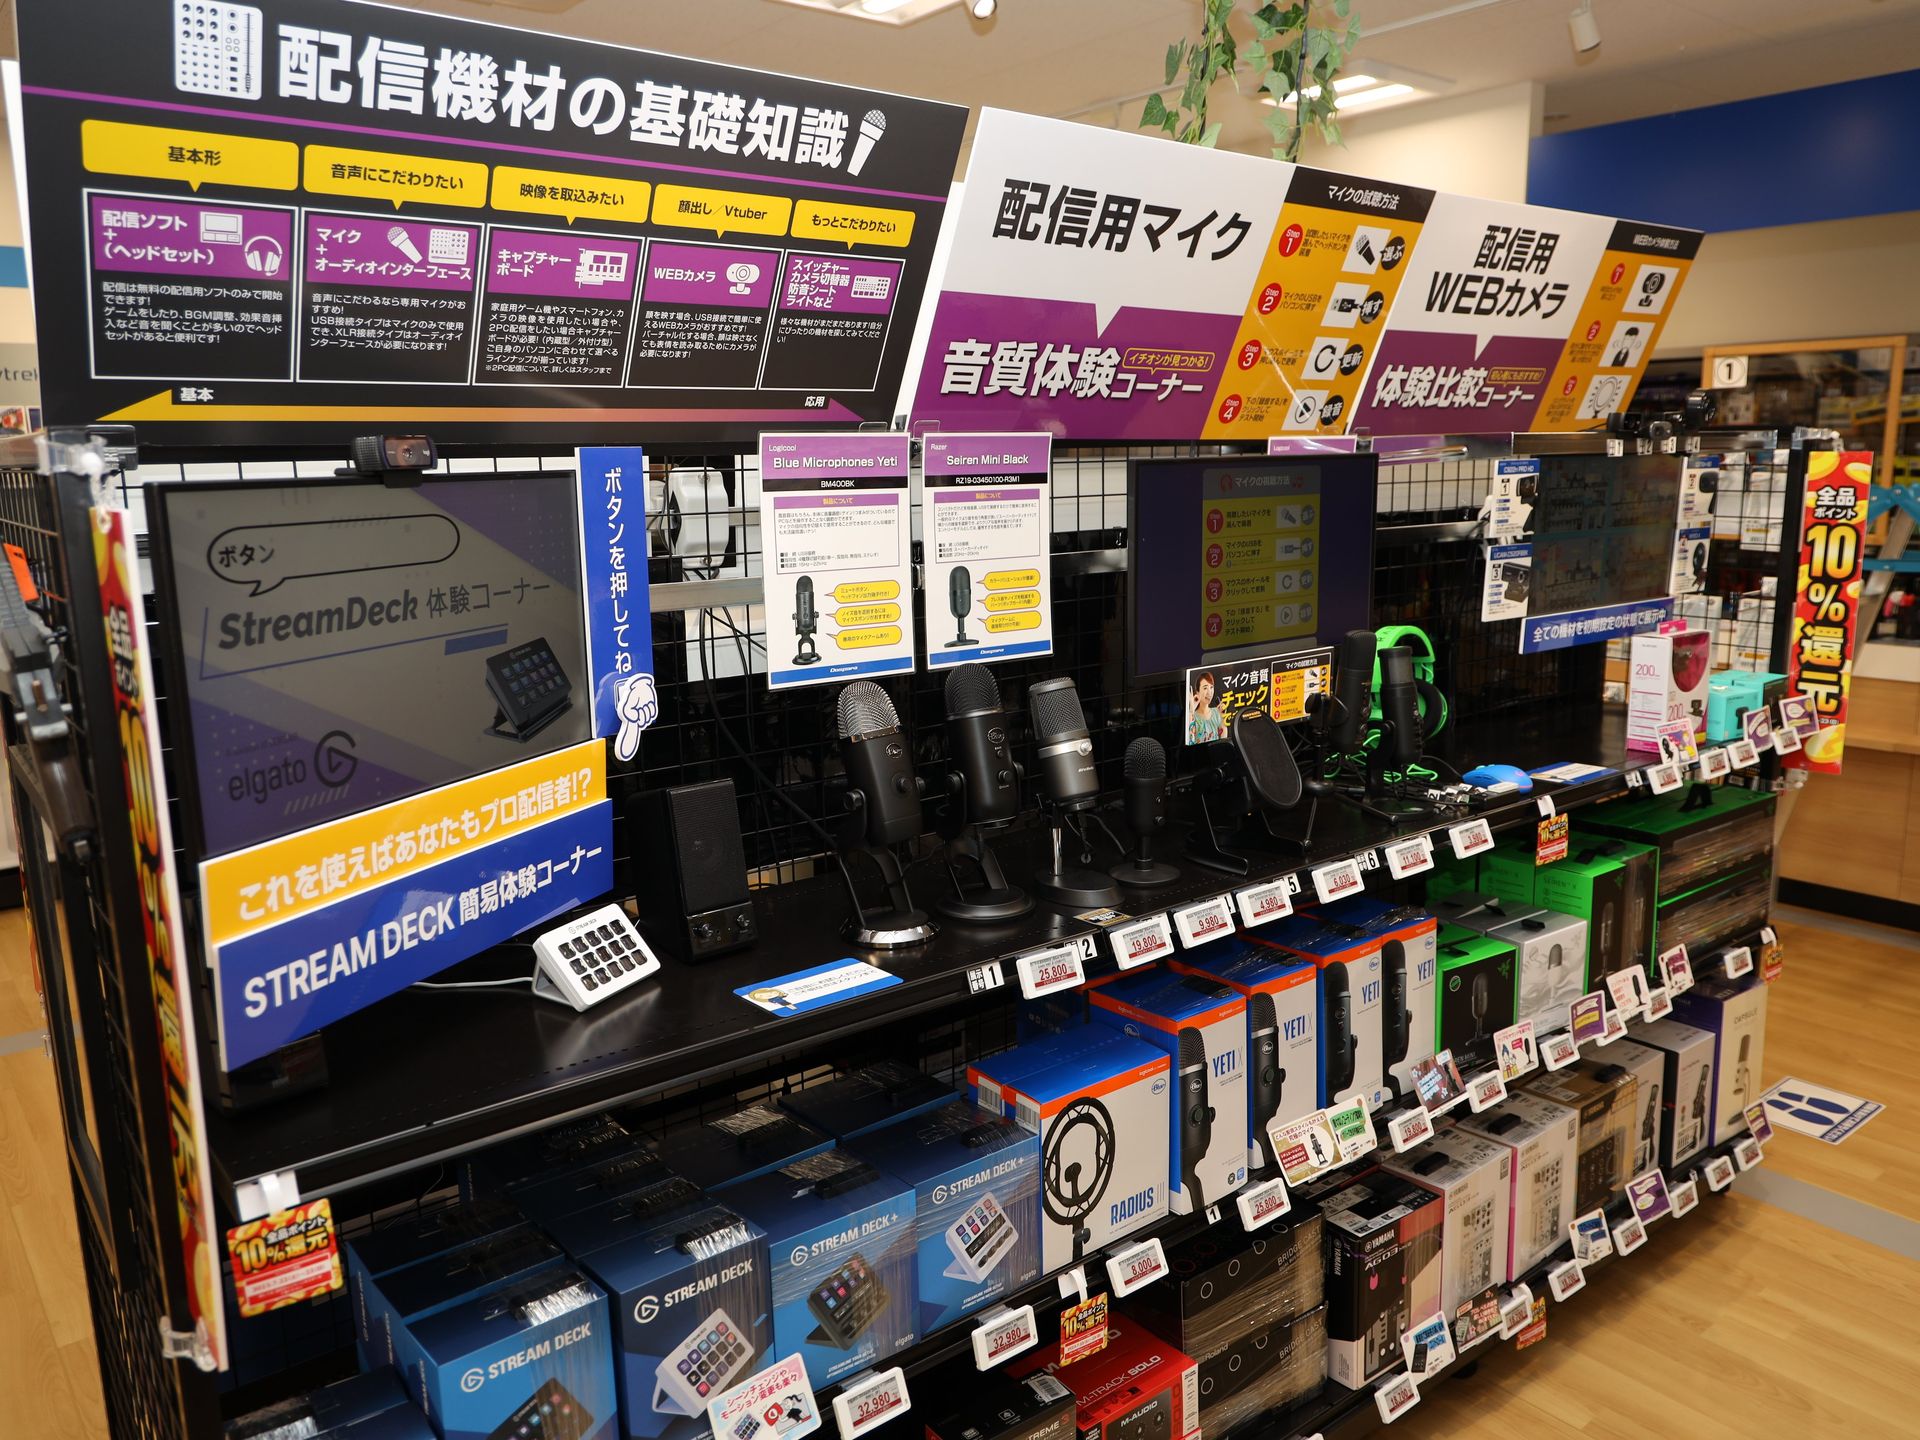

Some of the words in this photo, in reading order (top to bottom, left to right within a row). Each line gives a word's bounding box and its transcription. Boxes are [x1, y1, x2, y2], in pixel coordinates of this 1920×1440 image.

[278, 23, 851, 170] 配信機材の基礎知識
[167, 145, 222, 167] 基本形
[330, 163, 464, 191] 音声にこだわりたい
[519, 182, 625, 207] 映像を取込みたい
[1328, 185, 1400, 210] マイクの試聴方法
[101, 209, 188, 231] 配信ソフト
[811, 214, 897, 233] もっとこだわりたい
[992, 177, 1252, 261] 配信用マイク
[316, 227, 362, 244] マイク
[1286, 238, 1293, 253] 1
[497, 248, 572, 266] キャプチャー
[1381, 244, 1405, 262] 選ぶ
[1473, 224, 1560, 275] 配信用
[315, 257, 472, 281] オーディオインターフェース
[496, 263, 535, 278] ボード
[653, 267, 716, 283] WEBカメラ
[793, 259, 850, 273] スイッチャー
[790, 271, 851, 287] カメラ切替器
[102, 281, 283, 301] 配信は無料の配信用ソフトのみで開始
[787, 283, 837, 297] 防音シート
[1425, 270, 1570, 320] WEBカメラ
[311, 293, 466, 310] 音声にこだわるなら専用マイクがお
[786, 295, 834, 309] ライトなど
[1262, 296, 1274, 312] 2
[1361, 299, 1383, 317] 挿す
[103, 319, 282, 335] 入など音を聞くことが多いのでヘッド
[311, 315, 464, 332] USB接続タイプはマイクのみで使用
[486, 344, 619, 357] ご自身のパソコンに合わせて選べる
[1128, 351, 1211, 369] イチオシが見つかる!
[1242, 352, 1254, 367] 3
[1340, 352, 1363, 366] 更新
[939, 338, 1205, 401] 音質体験コーナー
[1726, 363, 1733, 380] 1
[179, 386, 214, 402] 基本
[1371, 364, 1535, 409] 体験比較コーナー
[804, 396, 825, 407] 応用
[1223, 407, 1233, 420] 4
[773, 457, 799, 469] Blue
[802, 455, 874, 469] Microphones
[875, 455, 898, 467] Yeti
[946, 455, 979, 466] Seiren
[980, 454, 1001, 465] Mini
[1002, 454, 1029, 465] Black
[1815, 486, 1856, 507] 全品
[1813, 507, 1858, 520] ポイント
[217, 544, 275, 567] ボタン
[604, 466, 632, 675] ボタンを押してね
[218, 588, 418, 650] StreamDeck
[425, 577, 551, 619] 体験コーナー
[1222, 667, 1269, 689] マイク音質
[1221, 684, 1269, 710] チェック
[228, 755, 306, 804] elgato
[239, 767, 592, 921] これを使えばあなたもプロ配信者!?
[1368, 851, 1375, 868] 6
[1288, 876, 1297, 893] 5
[244, 929, 377, 1018] STREAM
[382, 898, 455, 959] DECK
[459, 844, 602, 926] 簡易体験コーナー
[1081, 938, 1093, 959] 2
[988, 965, 997, 986] 1
[1417, 959, 1434, 982] YETI
[1361, 980, 1380, 1005] YETI
[1283, 1015, 1306, 1041] YETI
[1212, 1049, 1236, 1078] YETI
[949, 1171, 991, 1196] STREAM
[1110, 1187, 1154, 1227] RADIUS
[1208, 1208, 1217, 1222] 1
[266, 1215, 327, 1245] 全品ポイント
[1371, 1229, 1395, 1250] YAMAHA
[235, 1227, 329, 1273] 10%還元
[811, 1230, 859, 1257] STREAM
[1277, 1242, 1301, 1266] BRIDGE
[1302, 1225, 1321, 1246] CAST
[1364, 1245, 1398, 1271] AG03
[664, 1278, 719, 1308] STREAM
[721, 1258, 753, 1287] DECK
[894, 1332, 914, 1347] elgato
[1278, 1335, 1303, 1359] BRIDGE
[1305, 1317, 1323, 1340] CAST
[487, 1344, 551, 1380] STREAM
[554, 1321, 592, 1349] DECK
[1205, 1343, 1229, 1361] Roland
[1075, 1374, 1126, 1407] M-TRACK
[1127, 1355, 1161, 1377] SOLO
[1120, 1400, 1158, 1427] M-AUDIO
